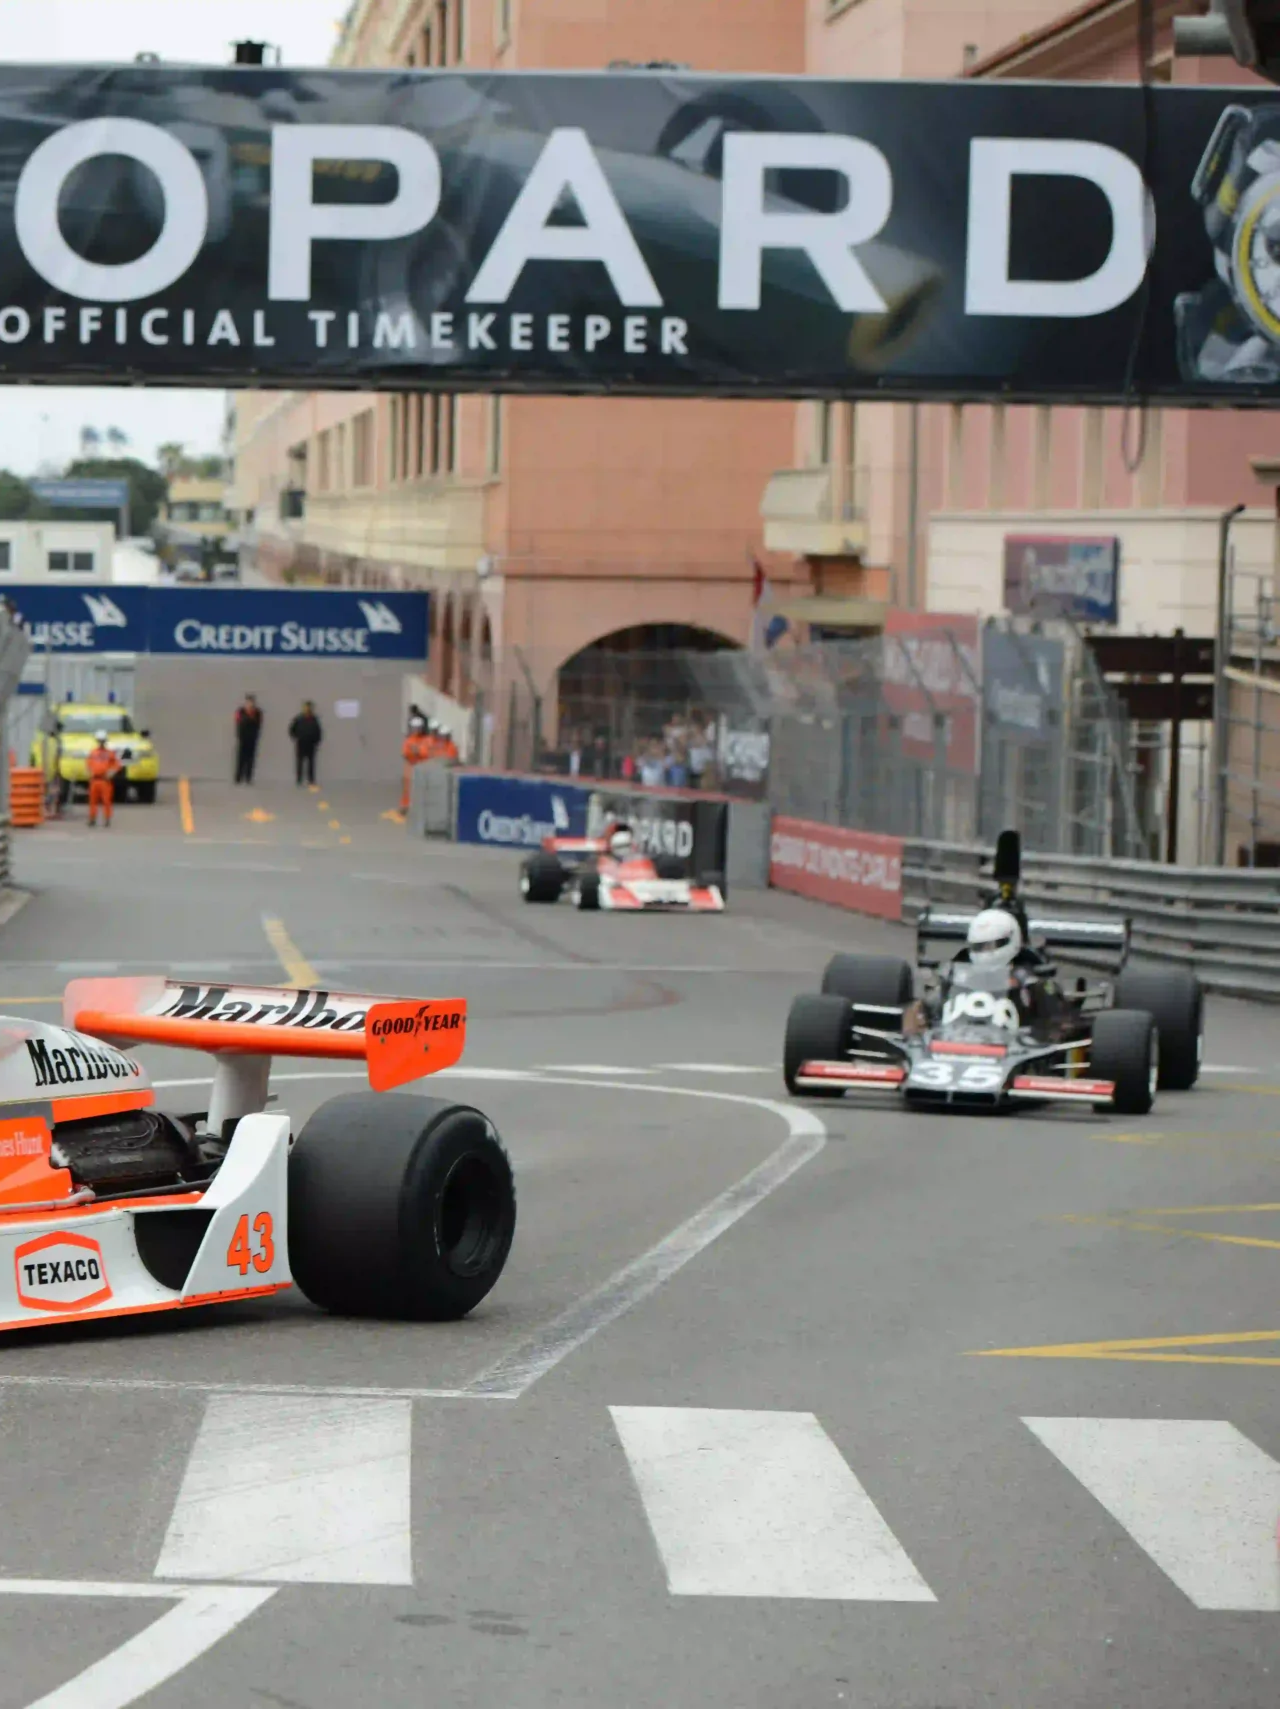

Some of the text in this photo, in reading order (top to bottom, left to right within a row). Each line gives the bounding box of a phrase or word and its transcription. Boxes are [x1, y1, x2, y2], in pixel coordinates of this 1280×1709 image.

[308, 310, 689, 354] TIMEKEEPER
[173, 619, 369, 653] CREDIT SUISSE
[159, 985, 366, 1033] Marlbo
[372, 1013, 460, 1036] GOOD YEAR
[25, 1029, 140, 1087] Marlboro
[909, 1062, 1003, 1088] 35
[15, 1132, 44, 1155] Hunt
[227, 1211, 275, 1275] 43
[24, 1258, 100, 1286] TEXACO
